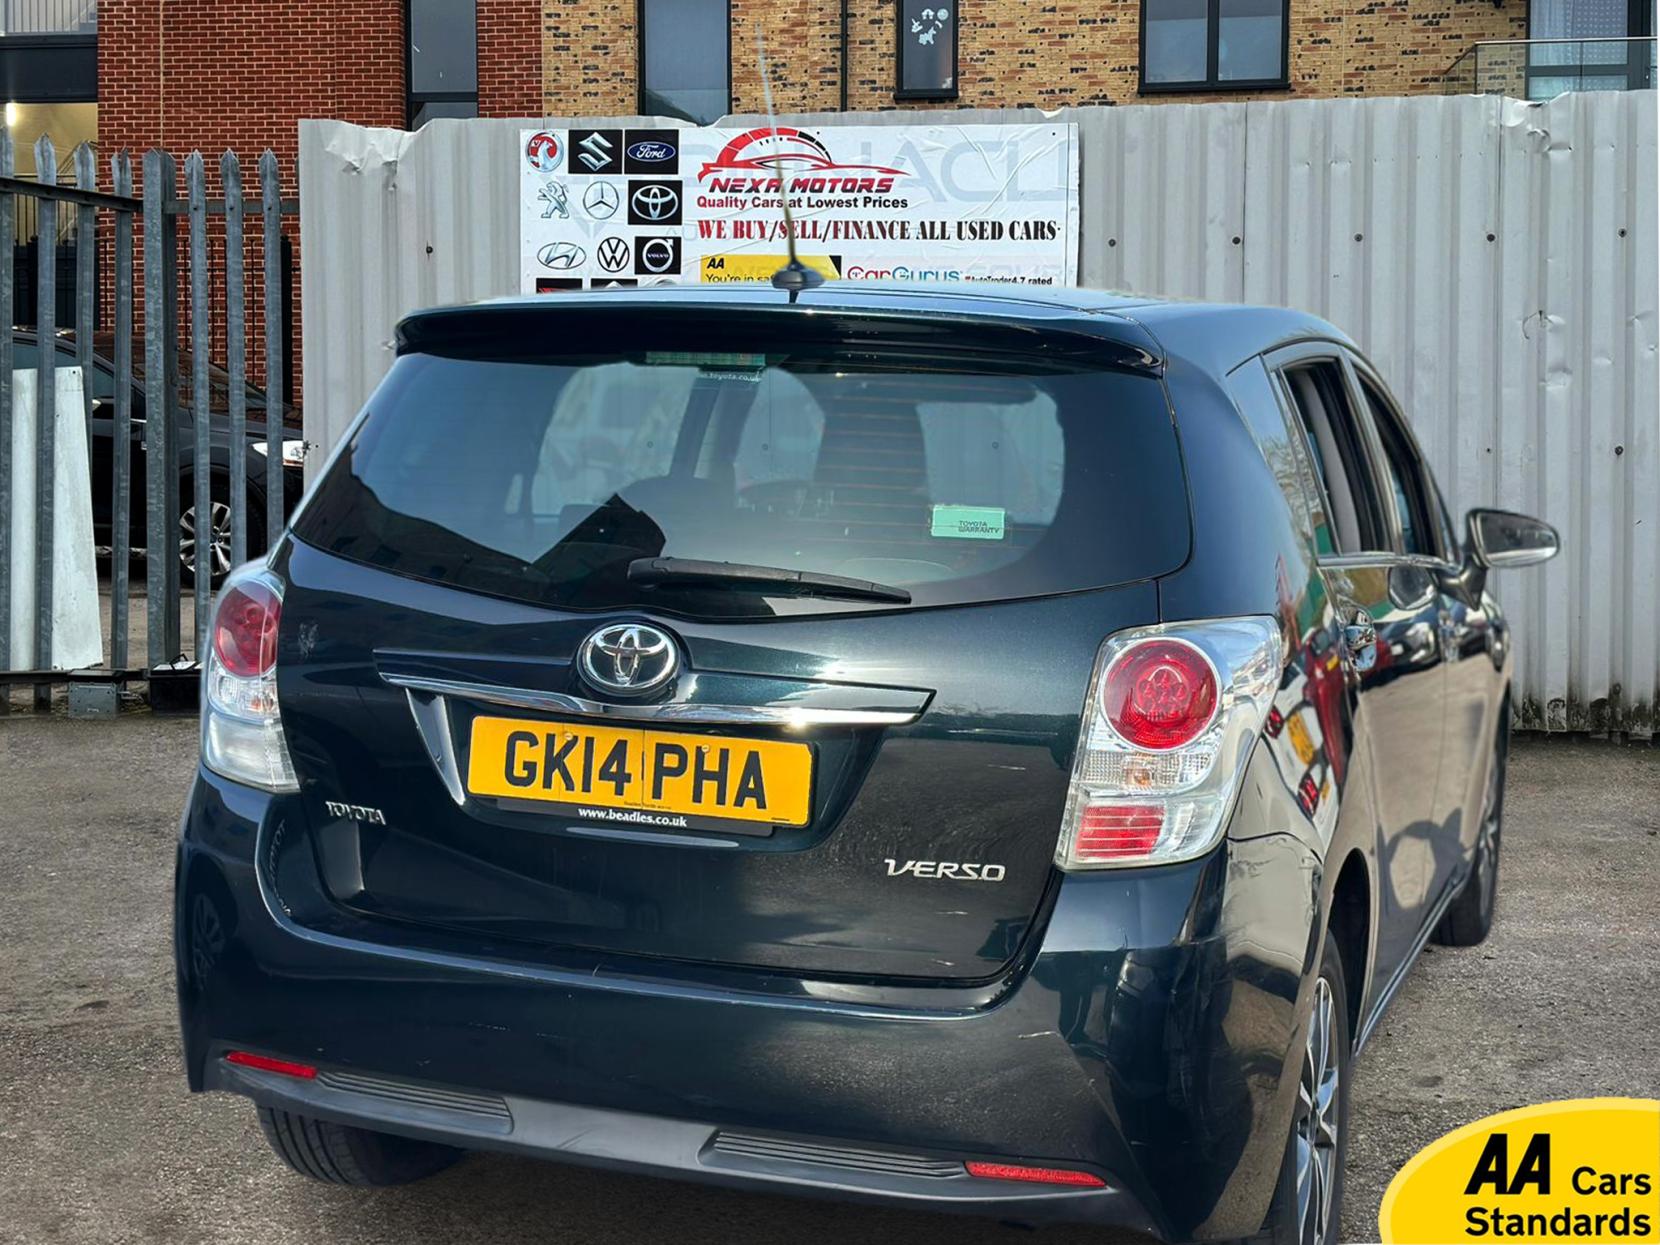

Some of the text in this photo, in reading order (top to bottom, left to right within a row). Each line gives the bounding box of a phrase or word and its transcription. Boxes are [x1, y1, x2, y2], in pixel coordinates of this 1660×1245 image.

[636, 144, 666, 159] Ford
[709, 178, 894, 194] NEXA MOTORS
[697, 196, 909, 210] Quality Cars at Lowest Prices
[697, 219, 727, 240] WE
[916, 220, 950, 240] ALL
[957, 220, 1004, 241] USED
[706, 257, 725, 269] AA
[847, 266, 960, 281] CarGurus
[1028, 276, 1053, 285] rated
[504, 730, 767, 810] GK14 PHA
[325, 801, 387, 826] TOYOTA
[578, 806, 688, 828] www.beadles.co.uk
[884, 858, 1006, 881] VERSO
